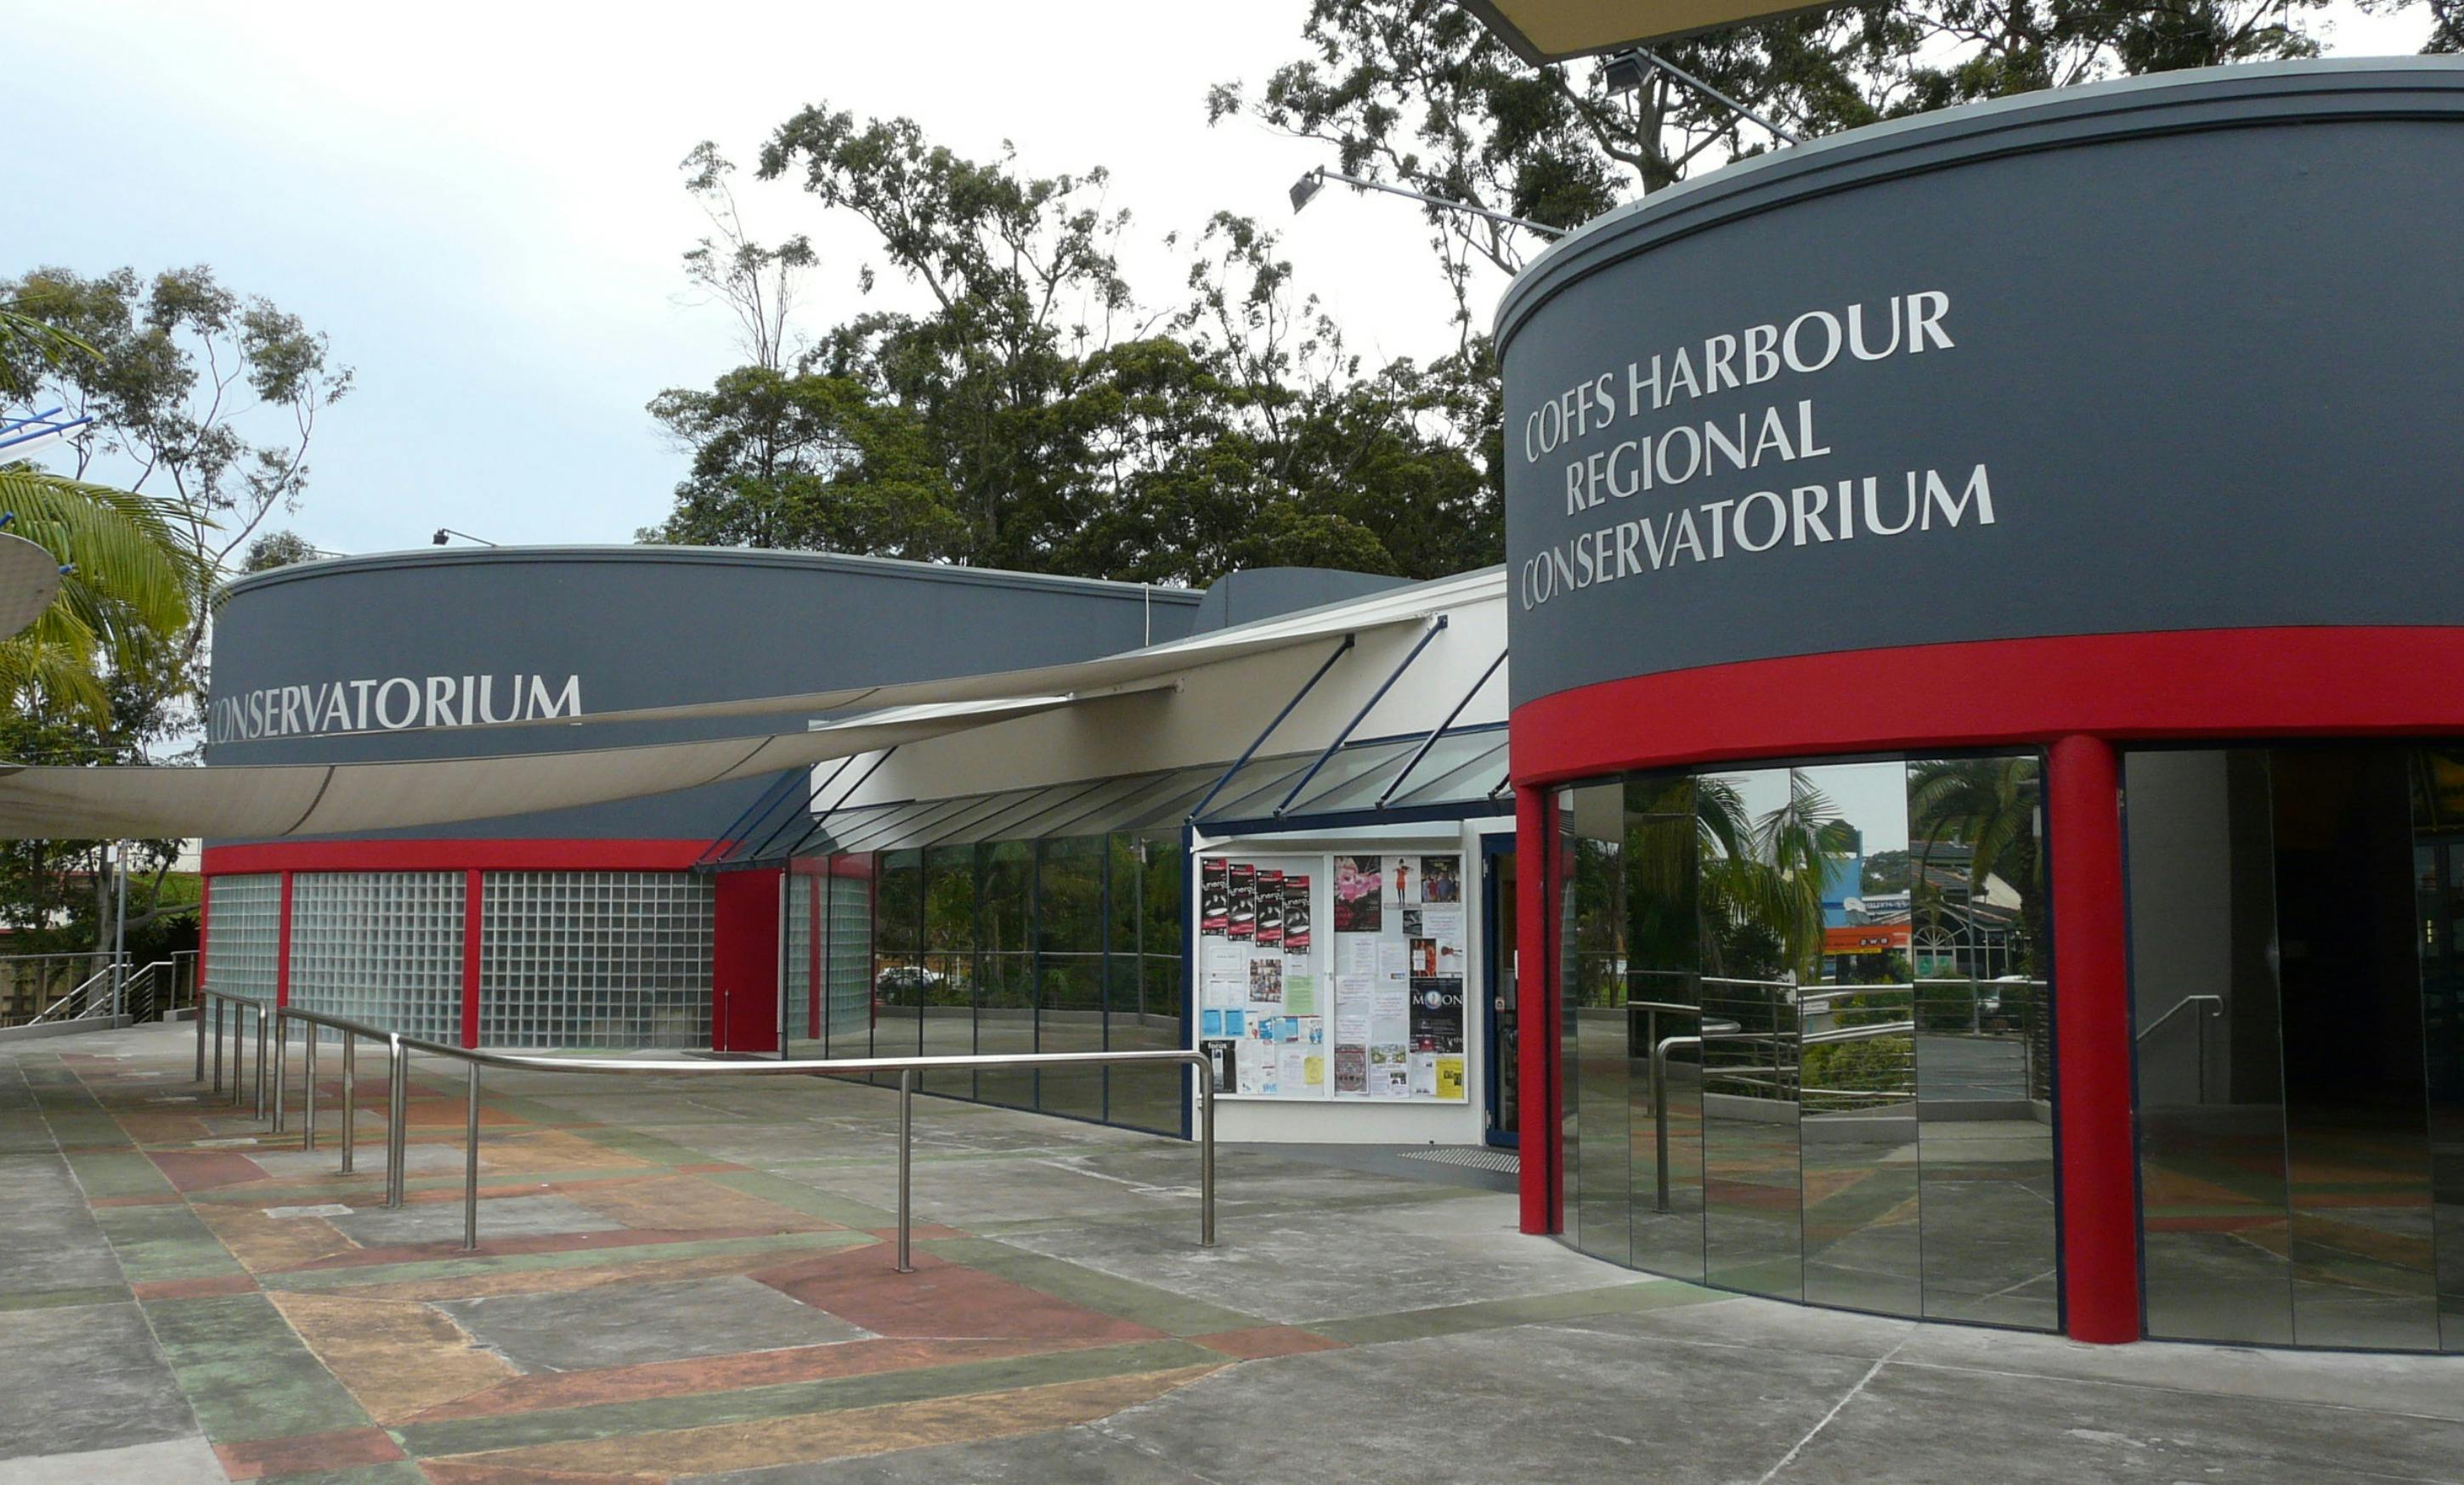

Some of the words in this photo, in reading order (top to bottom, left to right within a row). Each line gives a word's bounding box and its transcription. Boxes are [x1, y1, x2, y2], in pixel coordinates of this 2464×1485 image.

[1525, 372, 1614, 463] COFFS
[1628, 290, 1955, 418] HARBOUR
[1566, 399, 1831, 516] REGIONAL
[1522, 463, 1996, 611] CONSERVATORIUM
